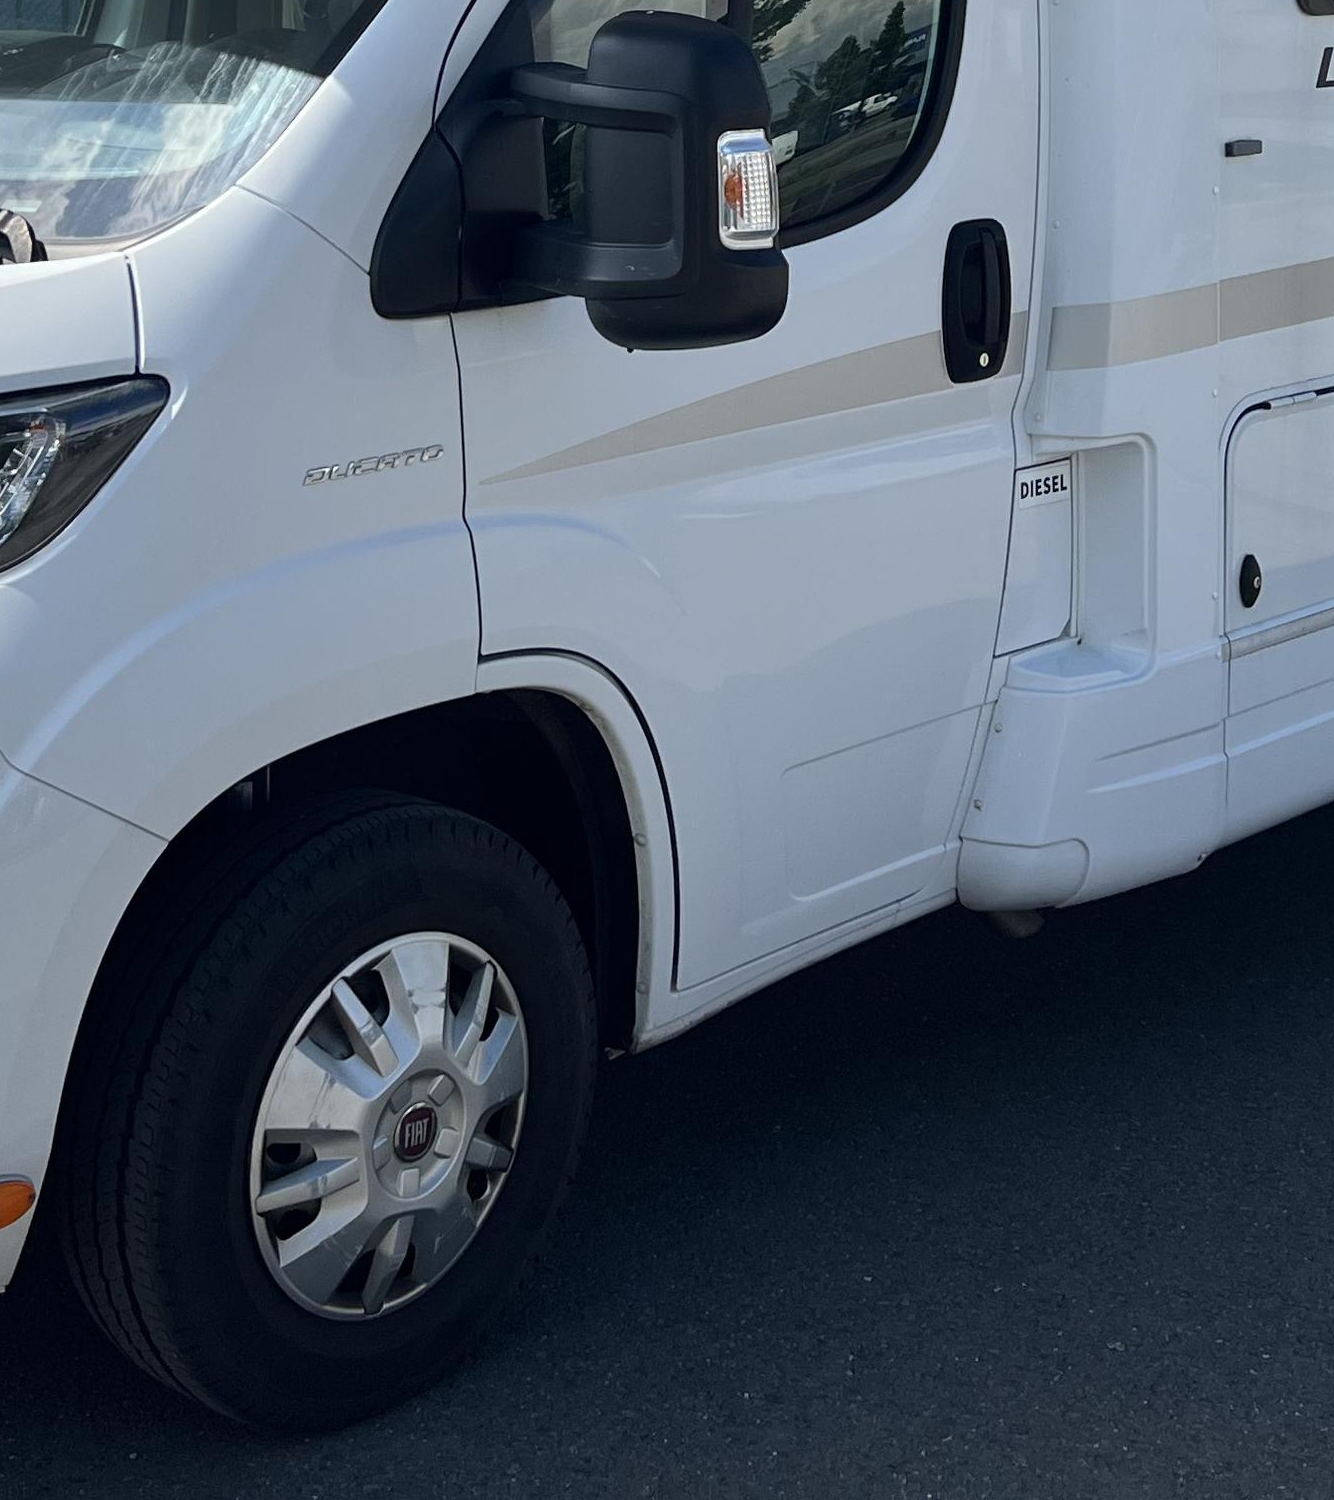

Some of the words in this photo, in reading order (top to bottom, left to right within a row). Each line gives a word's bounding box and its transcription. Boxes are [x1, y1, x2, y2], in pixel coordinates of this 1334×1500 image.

[302, 444, 444, 486] DUCATO
[1020, 474, 1068, 500] DIESEL
[405, 1117, 429, 1149] FIAT
